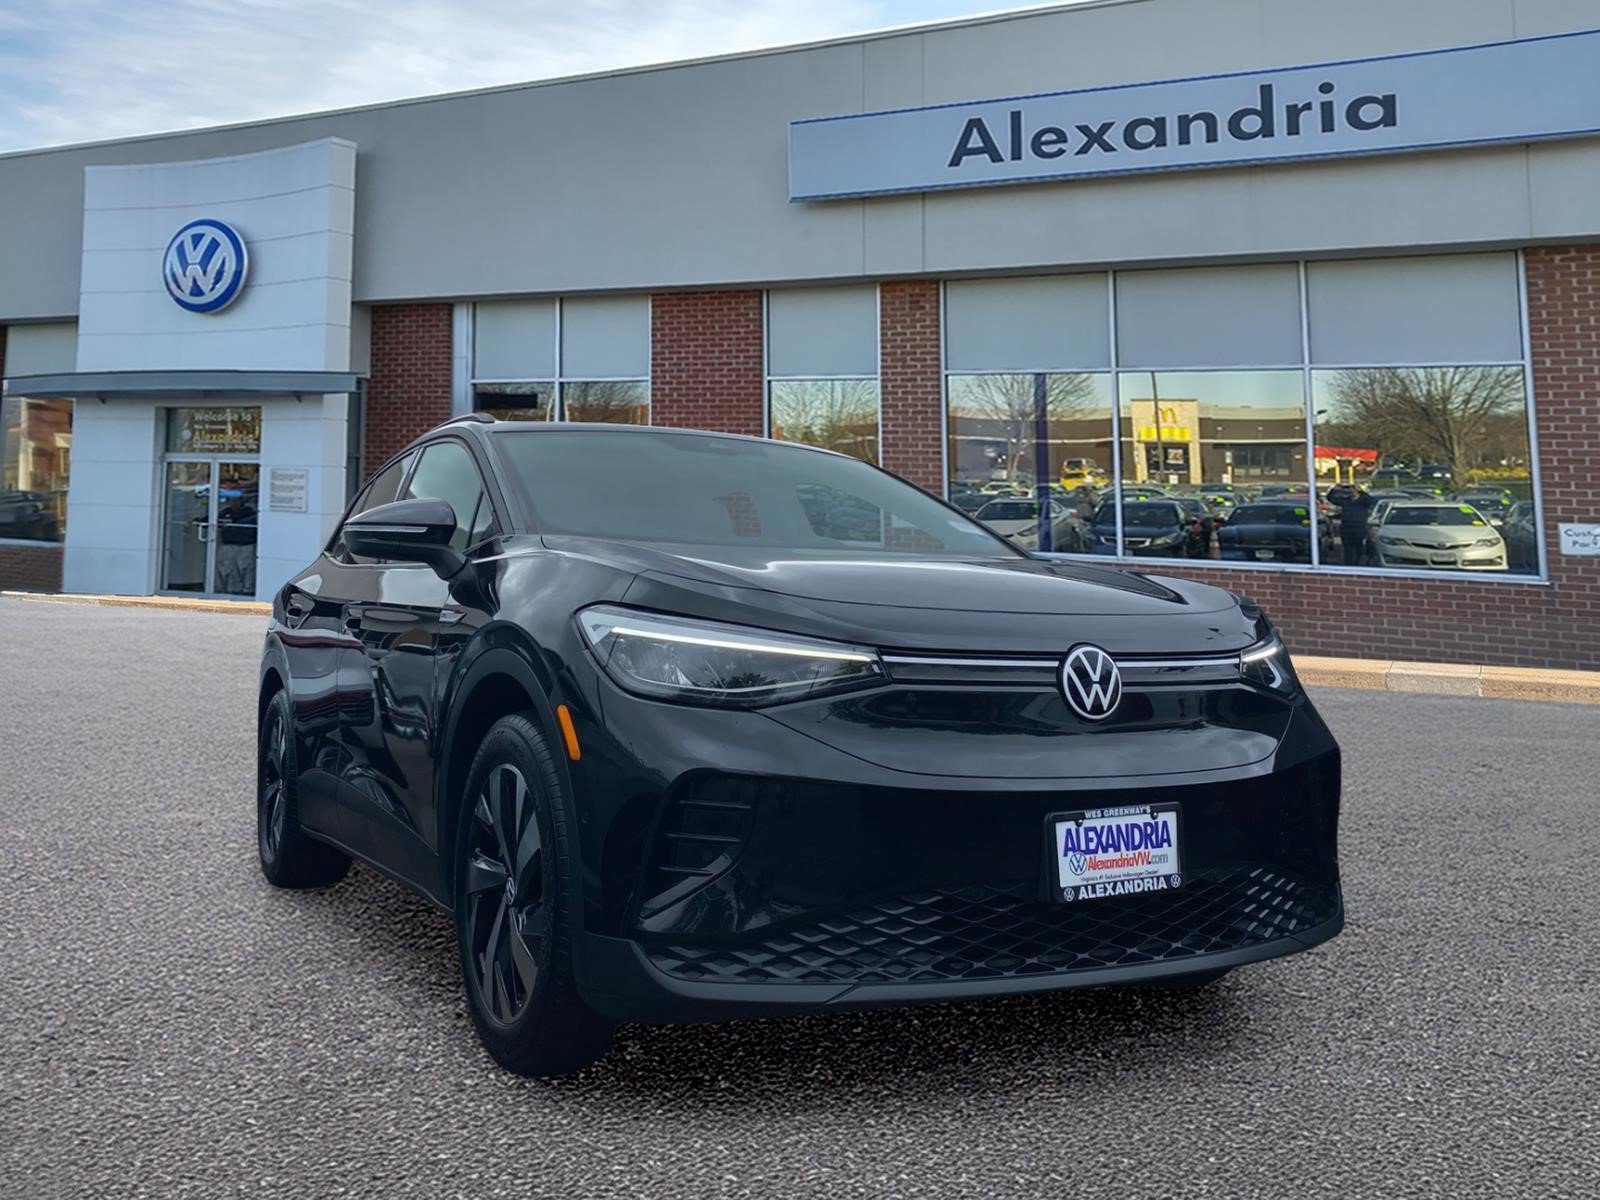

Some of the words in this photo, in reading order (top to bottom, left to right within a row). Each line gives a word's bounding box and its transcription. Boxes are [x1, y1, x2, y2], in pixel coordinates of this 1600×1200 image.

[947, 81, 1398, 167] Alexandria
[1085, 810, 1101, 819] WES
[1063, 820, 1172, 857] ALEXANDRIA
[1087, 851, 1168, 872] AlexandriaVW.com
[1078, 876, 1167, 900] ALEXANDRIA
